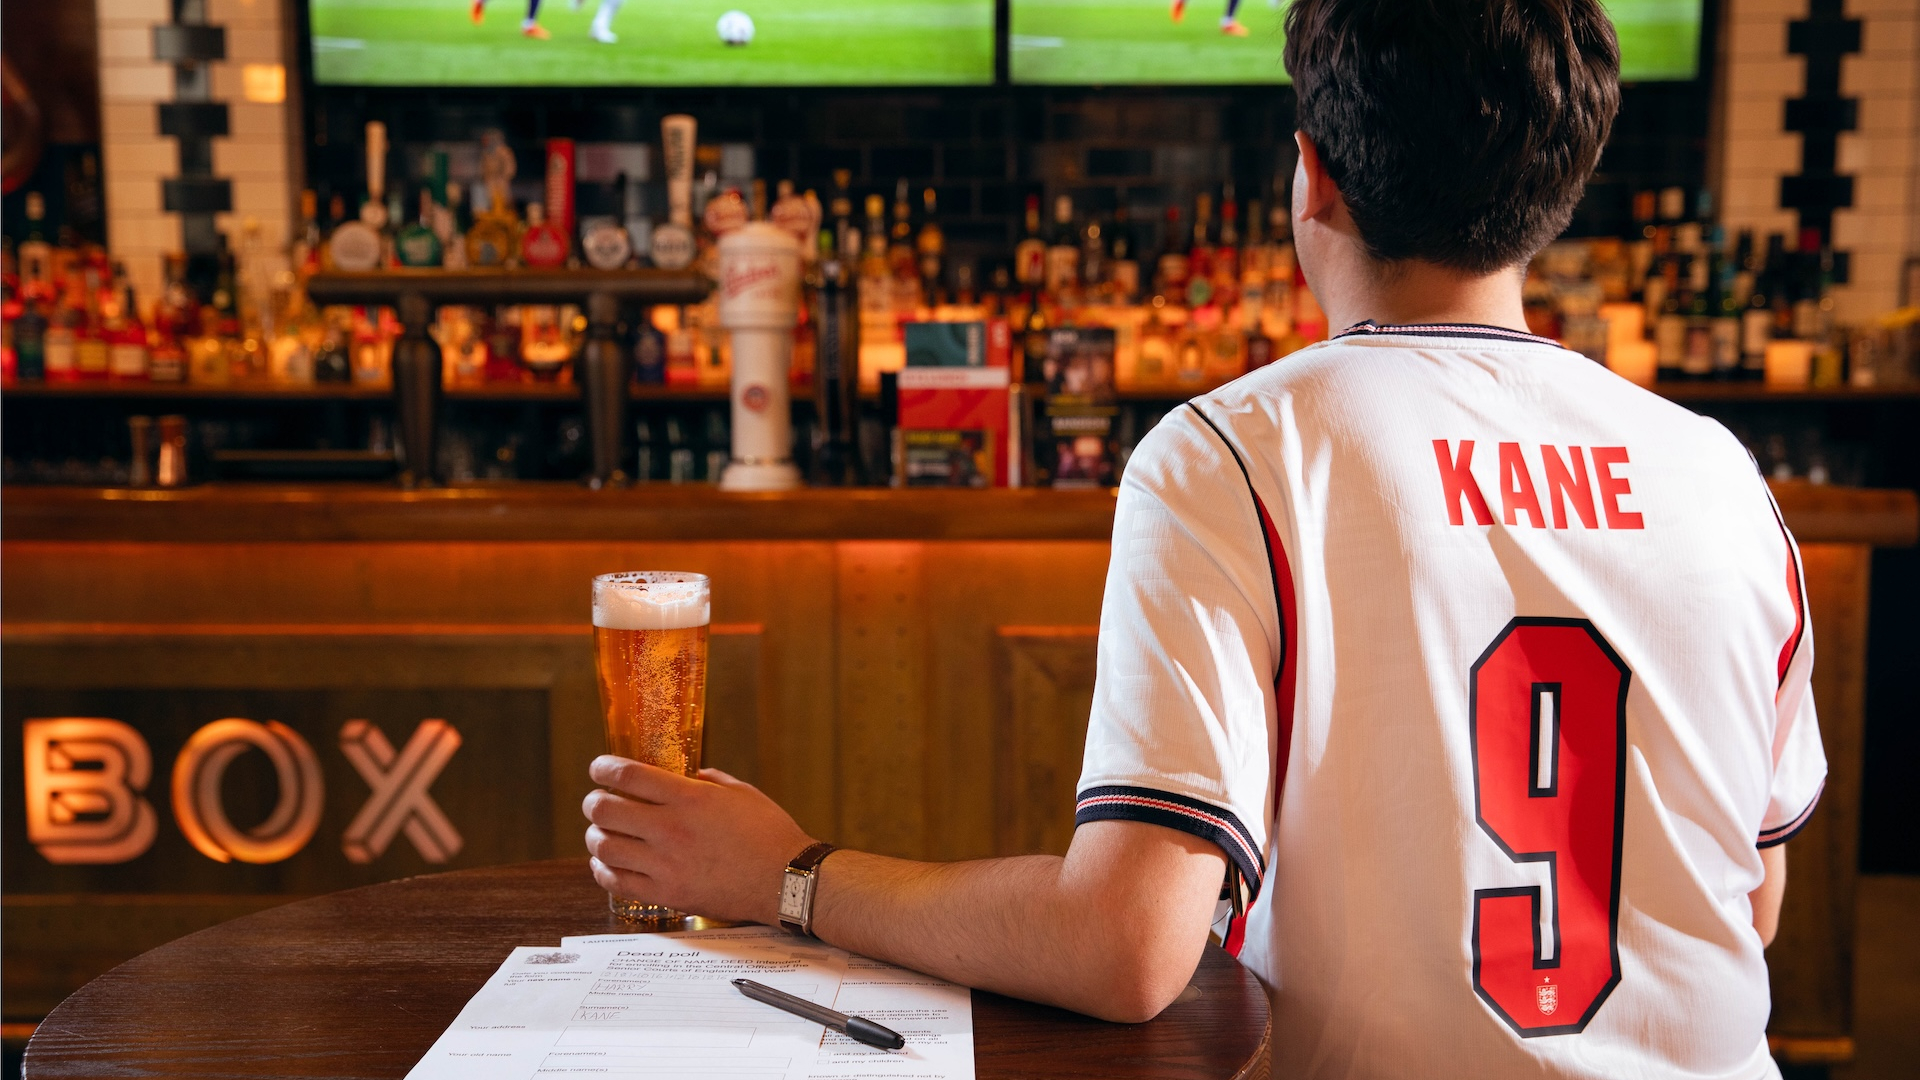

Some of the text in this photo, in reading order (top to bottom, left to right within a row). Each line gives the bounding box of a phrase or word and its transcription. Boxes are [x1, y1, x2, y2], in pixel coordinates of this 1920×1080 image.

[1432, 439, 1644, 530] KANE
[23, 717, 464, 865] BOX
[1469, 616, 1632, 1038] 9
[580, 1010, 621, 1020] KANE
[595, 983, 648, 991] HARRY
